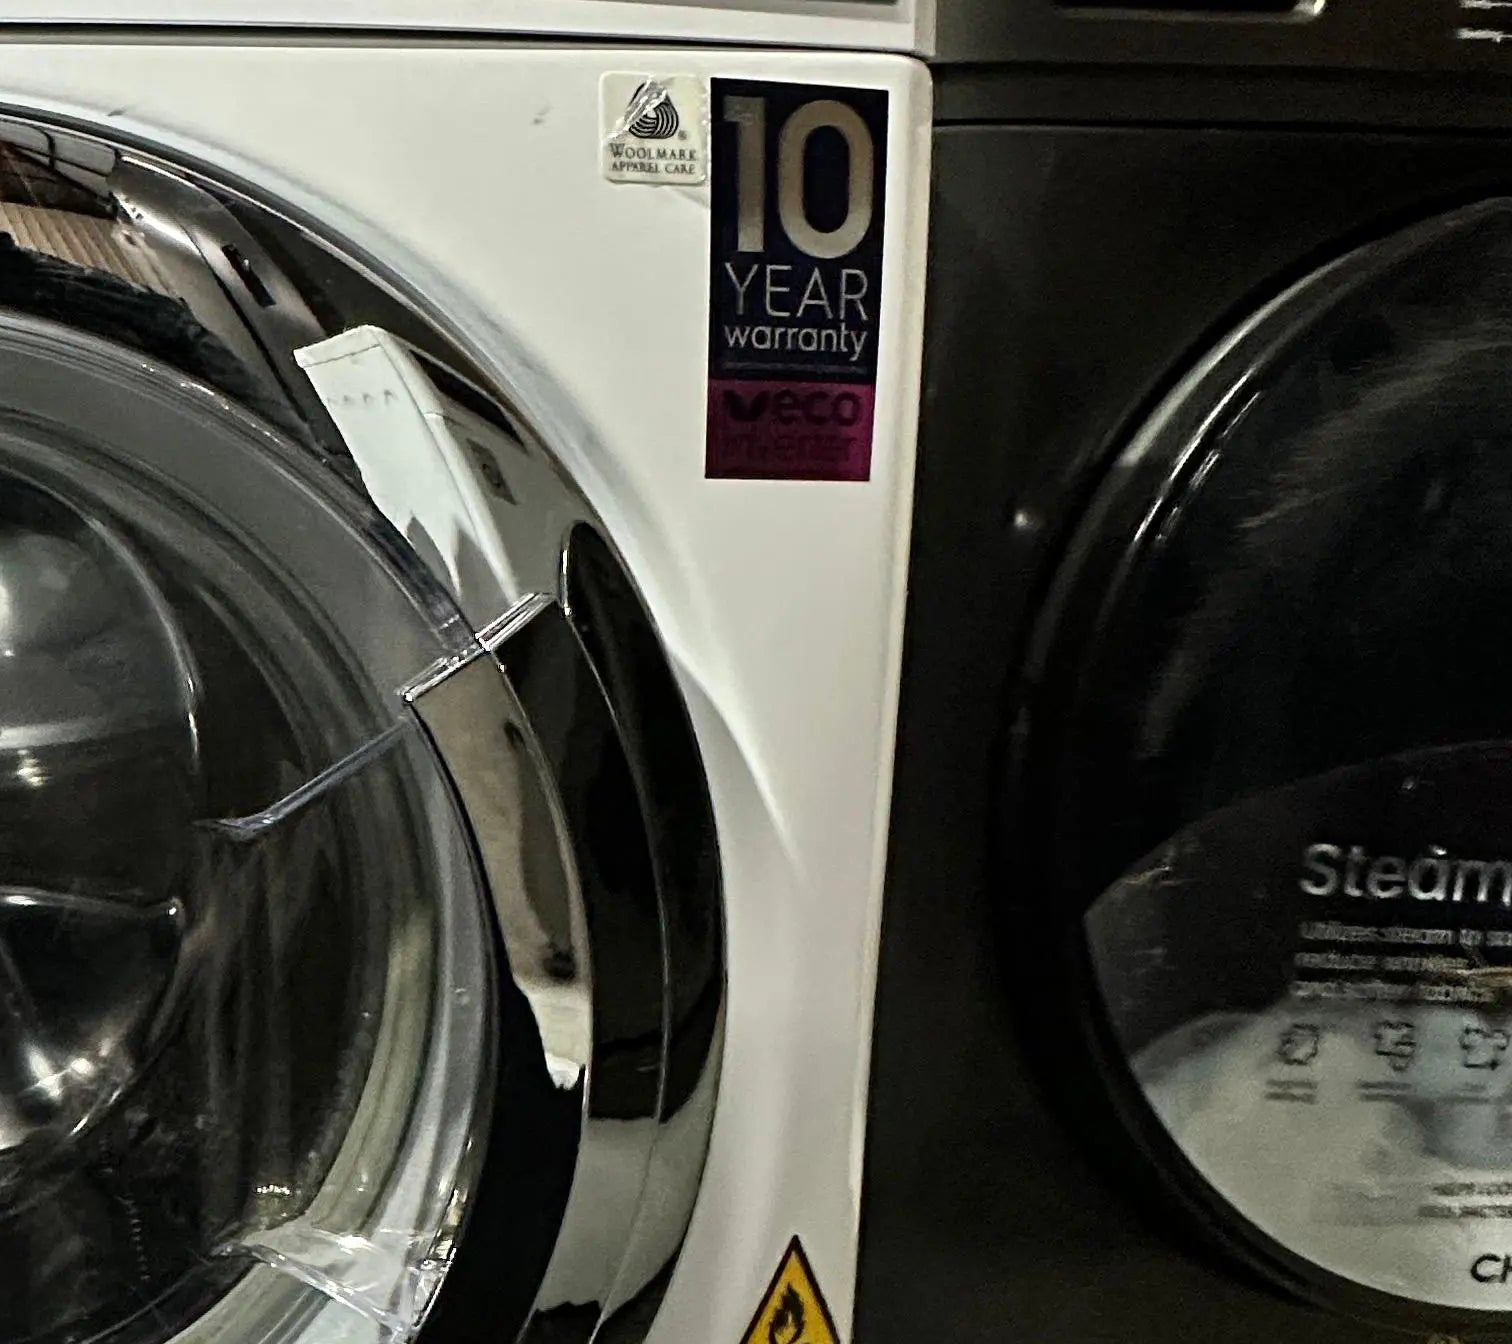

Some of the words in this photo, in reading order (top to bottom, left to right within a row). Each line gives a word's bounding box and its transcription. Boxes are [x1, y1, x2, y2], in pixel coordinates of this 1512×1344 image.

[724, 96, 873, 259] 10
[725, 262, 869, 321] YEAR
[724, 324, 867, 360] warranty
